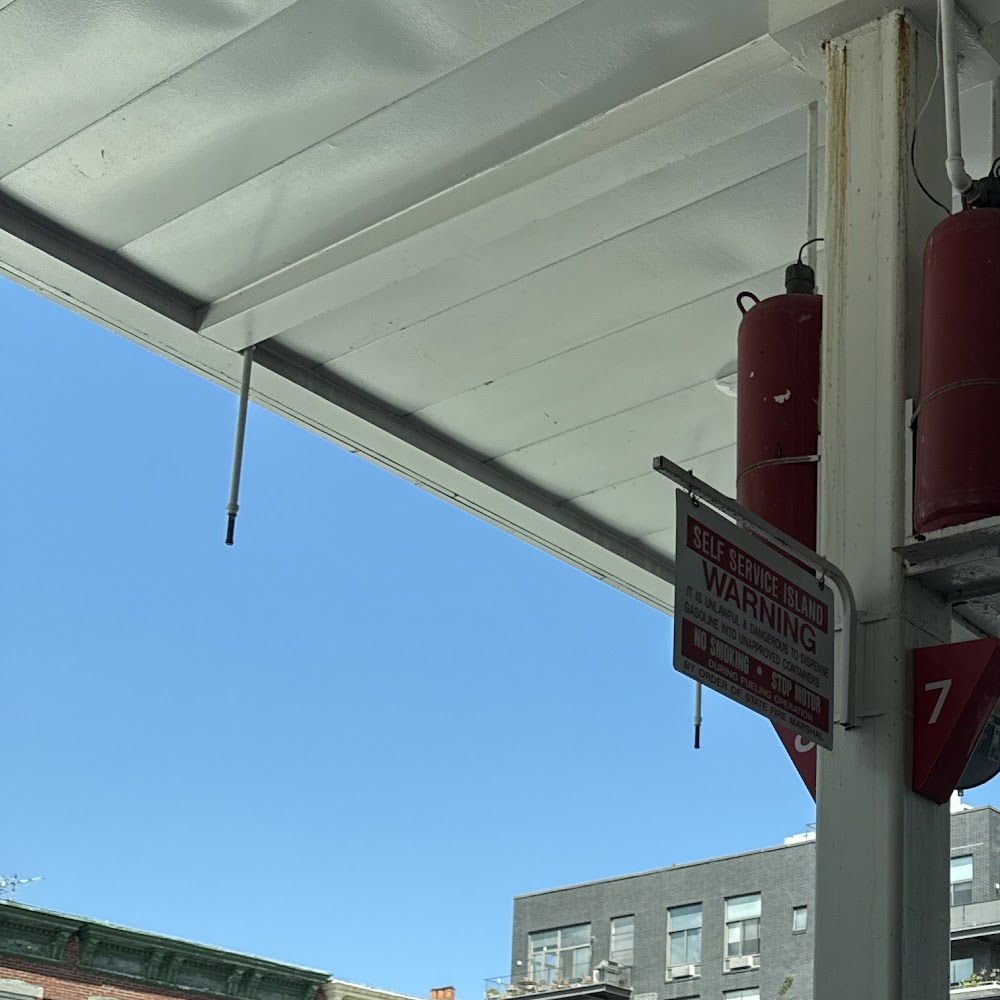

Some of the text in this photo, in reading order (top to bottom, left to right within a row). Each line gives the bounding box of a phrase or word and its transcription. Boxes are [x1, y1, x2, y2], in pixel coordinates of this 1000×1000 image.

[693, 525, 823, 626] SELF SERVICE ISLAND
[703, 560, 816, 654] WARNING
[684, 601, 820, 688] GASOLINE INTO UNAPPROVED CONTAINERS
[687, 585, 829, 679] IT IS UNLAWFUL & DANGEROUS TO DISPENSE
[693, 627, 822, 715] NO SMOKING STOP MOTOR
[684, 660, 824, 741] BY ORDER OF STATE FIRE MARSHAL
[707, 658, 814, 722] DURING FUELING OPERATION
[925, 679, 952, 725] 7
